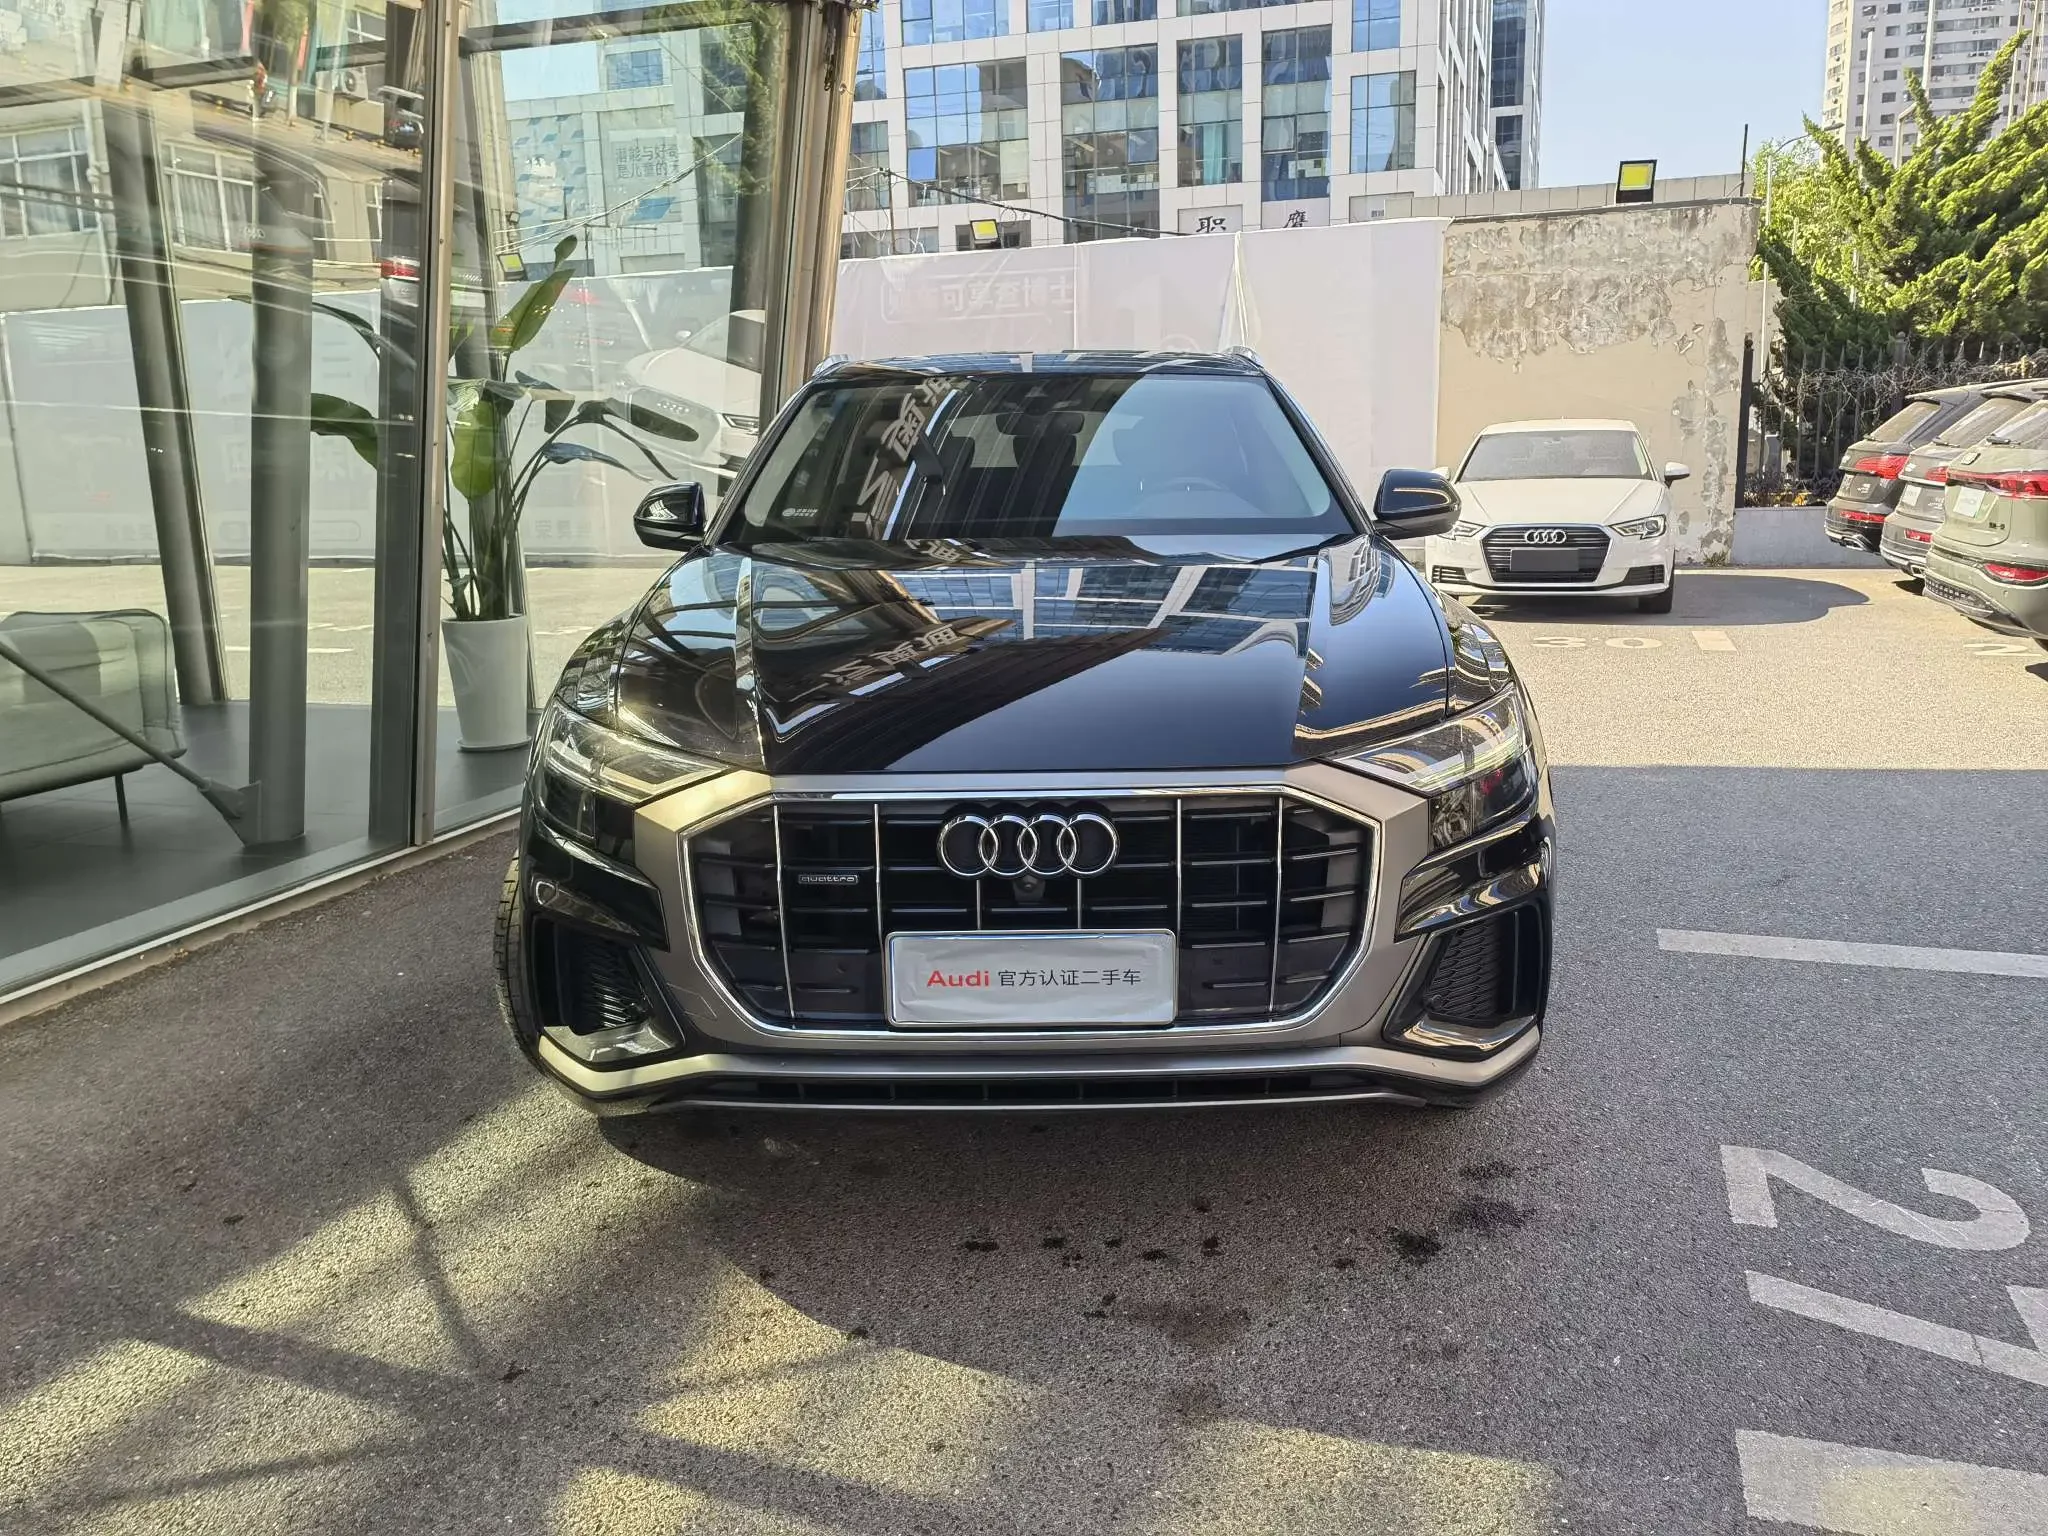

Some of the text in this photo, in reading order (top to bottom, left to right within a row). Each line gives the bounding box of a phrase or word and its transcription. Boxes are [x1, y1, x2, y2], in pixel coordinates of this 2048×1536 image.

[1531, 636, 1663, 648] 30
[800, 875, 856, 884] quattro
[927, 969, 1141, 987] Audi 官方认证二手车
